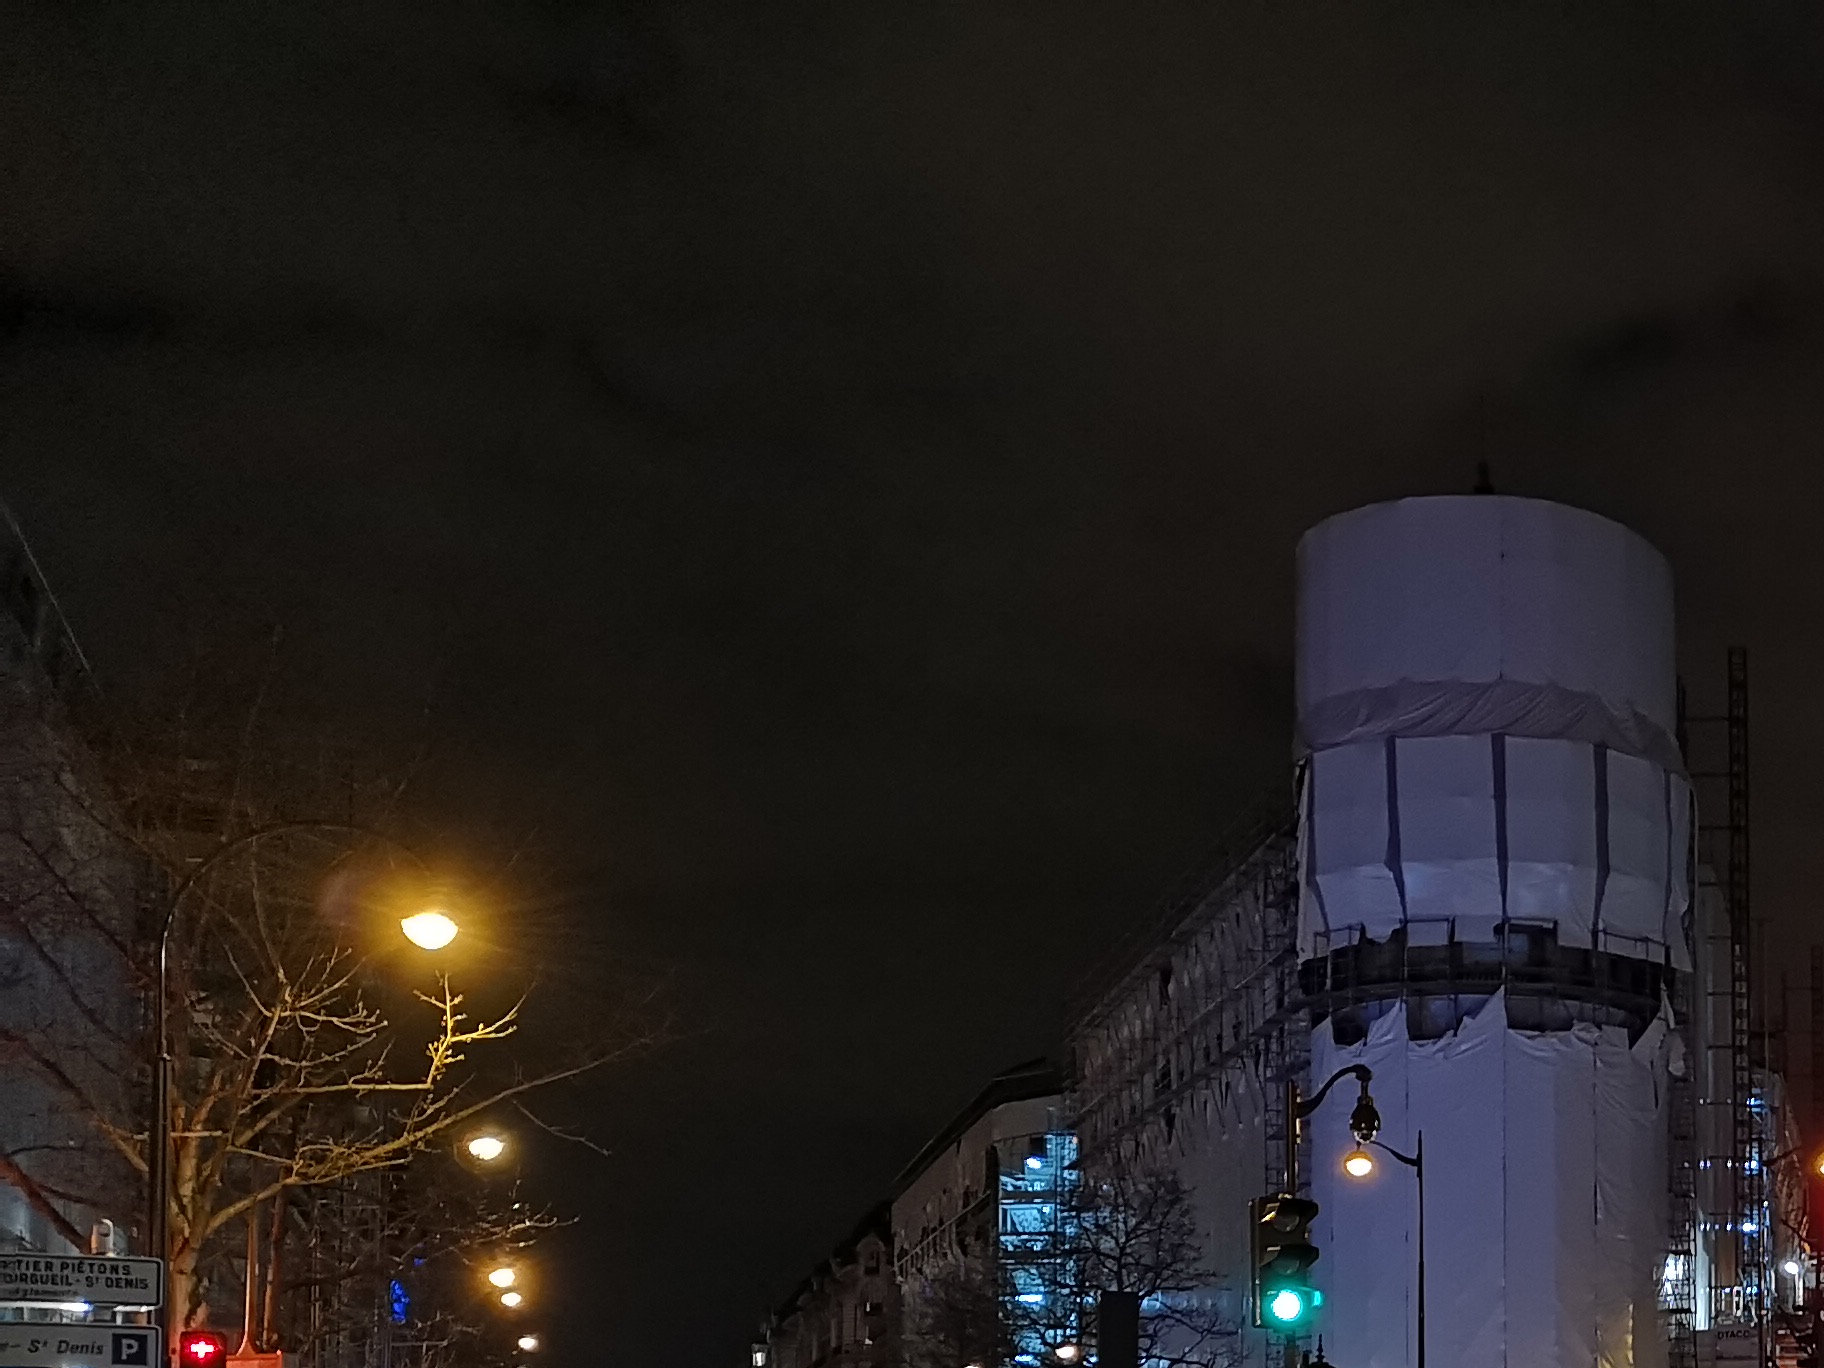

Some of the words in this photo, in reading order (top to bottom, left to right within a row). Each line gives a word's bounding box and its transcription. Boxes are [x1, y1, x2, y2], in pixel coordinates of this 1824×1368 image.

[60, 1260, 132, 1275] PIÉTONS
[105, 1277, 149, 1289] DENIS
[57, 1339, 104, 1355] Denis
[121, 1338, 139, 1360] P
